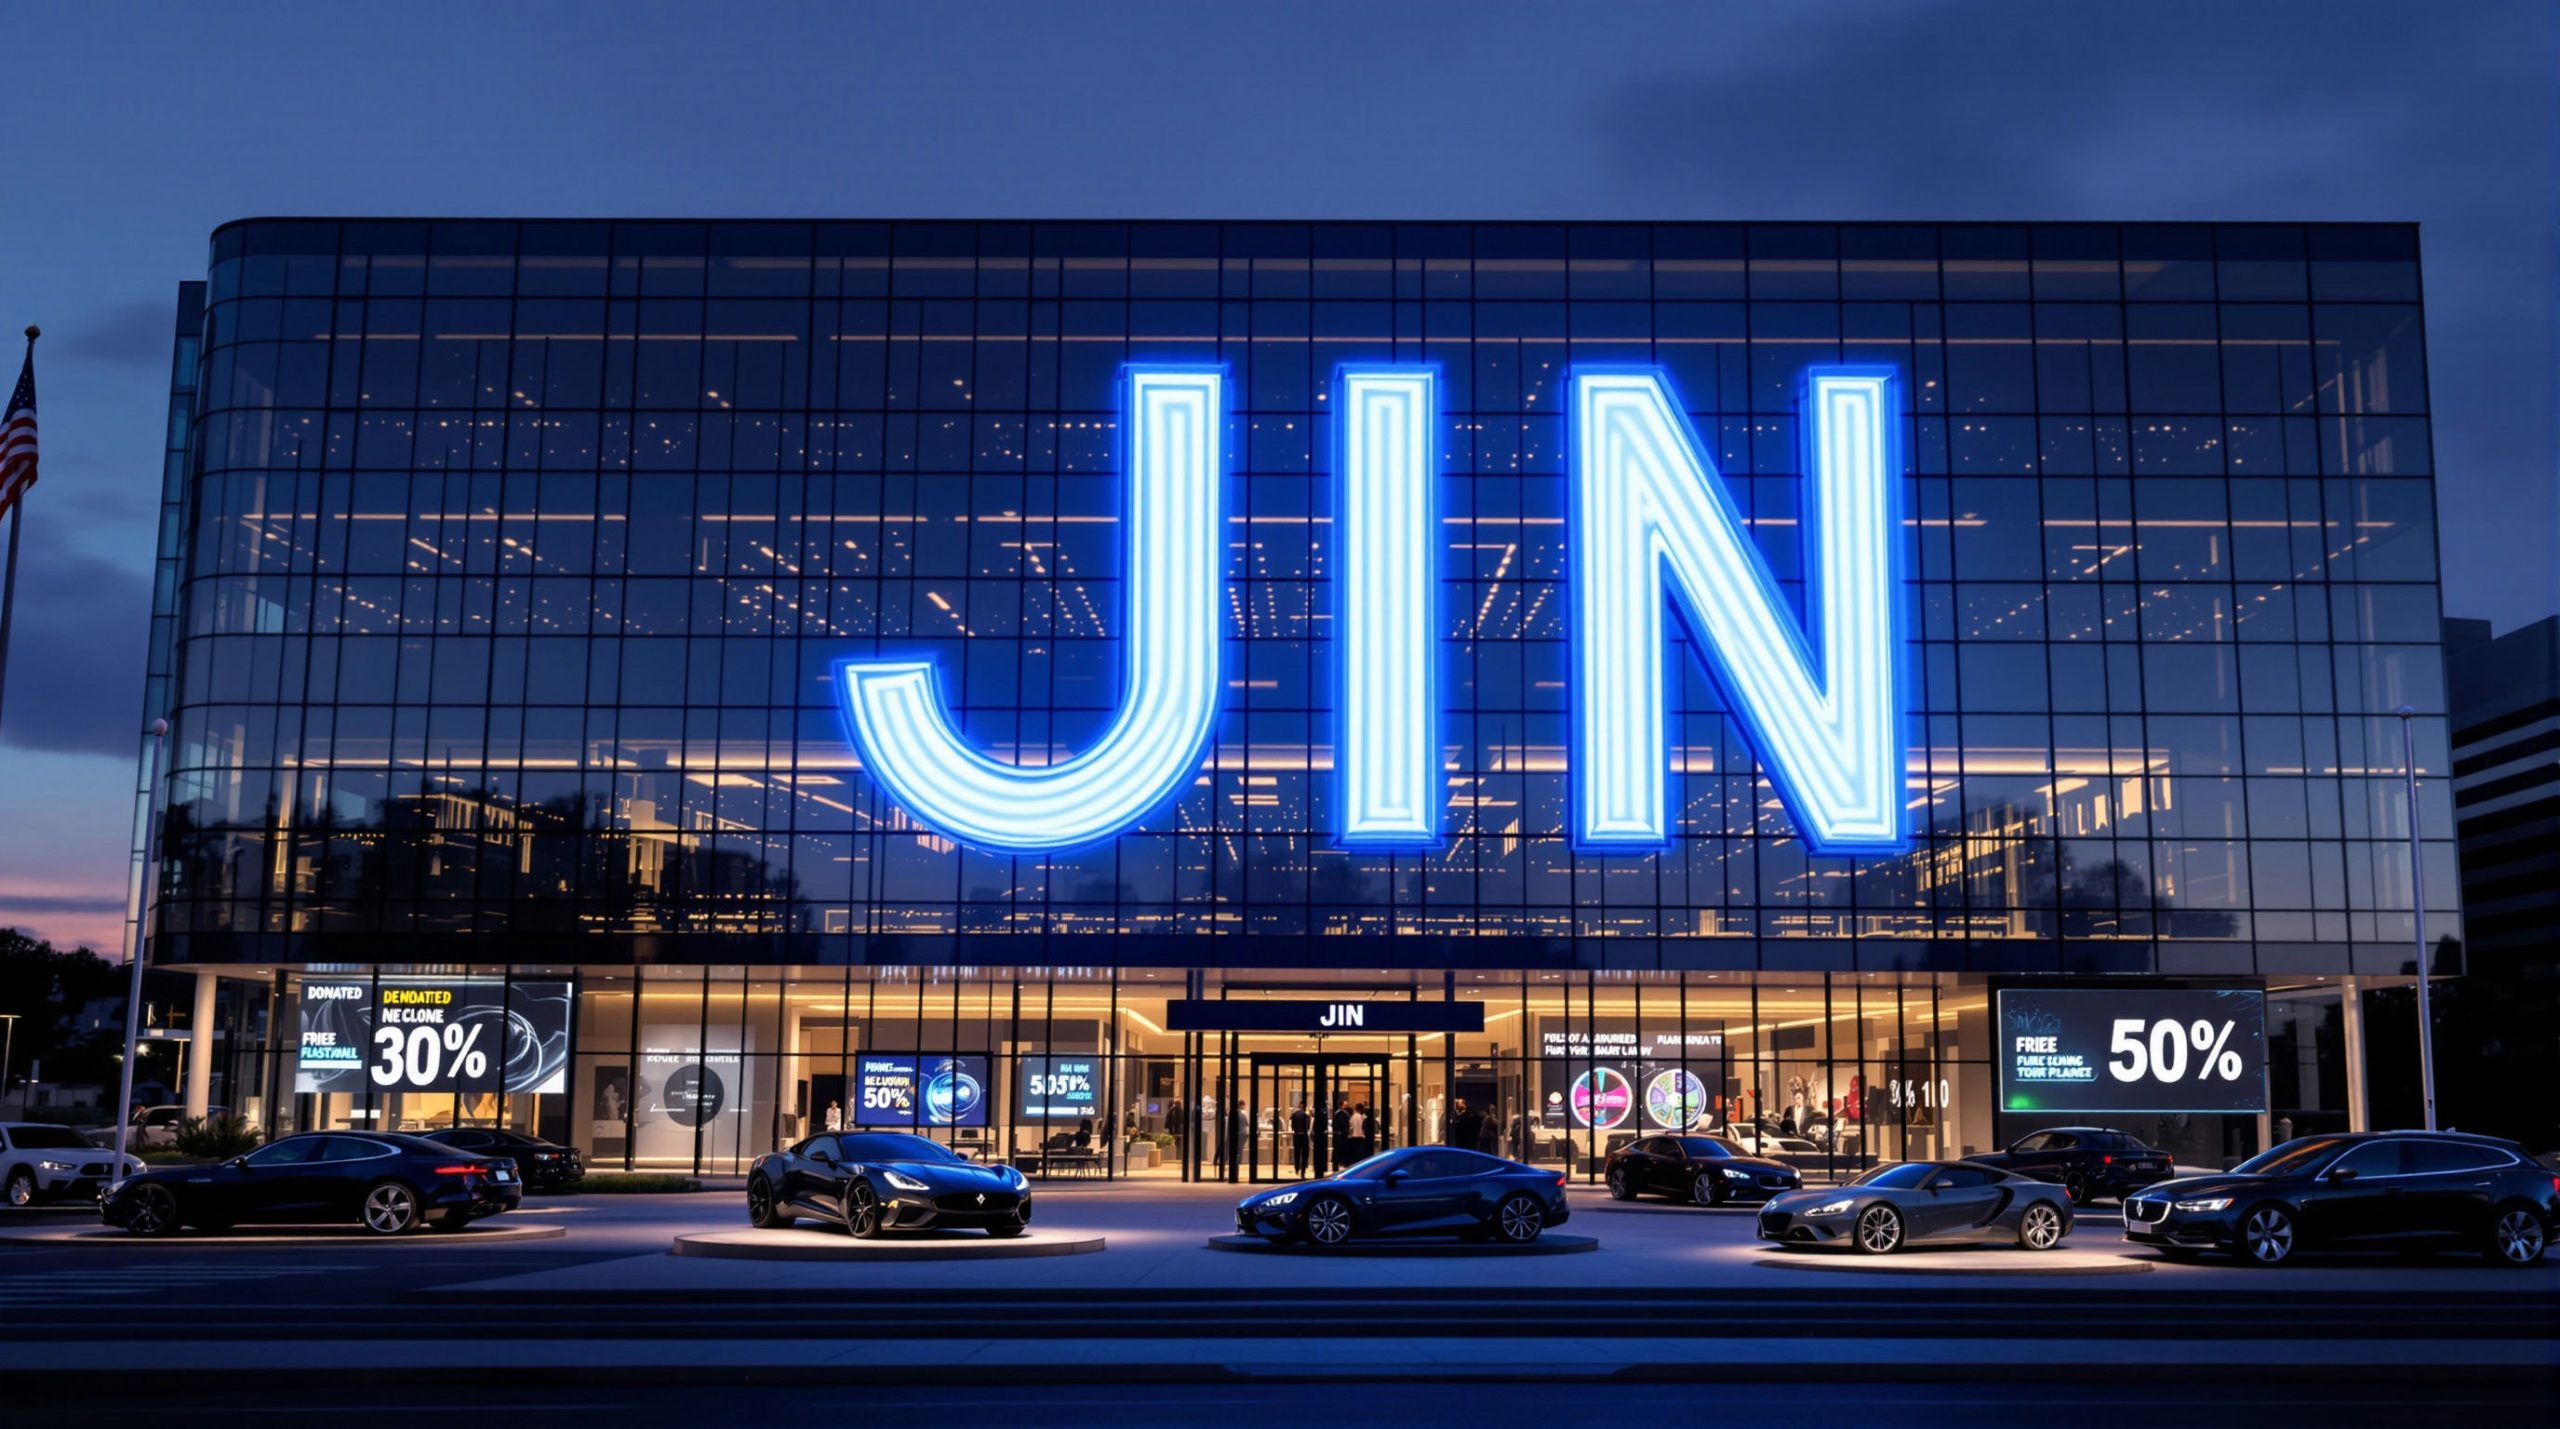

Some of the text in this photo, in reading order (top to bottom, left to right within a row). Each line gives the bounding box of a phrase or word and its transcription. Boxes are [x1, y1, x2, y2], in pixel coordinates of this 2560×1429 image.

[836, 362, 1908, 856] JIN
[307, 985, 363, 1000] DONATED
[1320, 1004, 1363, 1027] JIN
[371, 1022, 487, 1086] 30%
[2108, 1018, 2243, 1084] 50%
[864, 1087, 911, 1109] 50%
